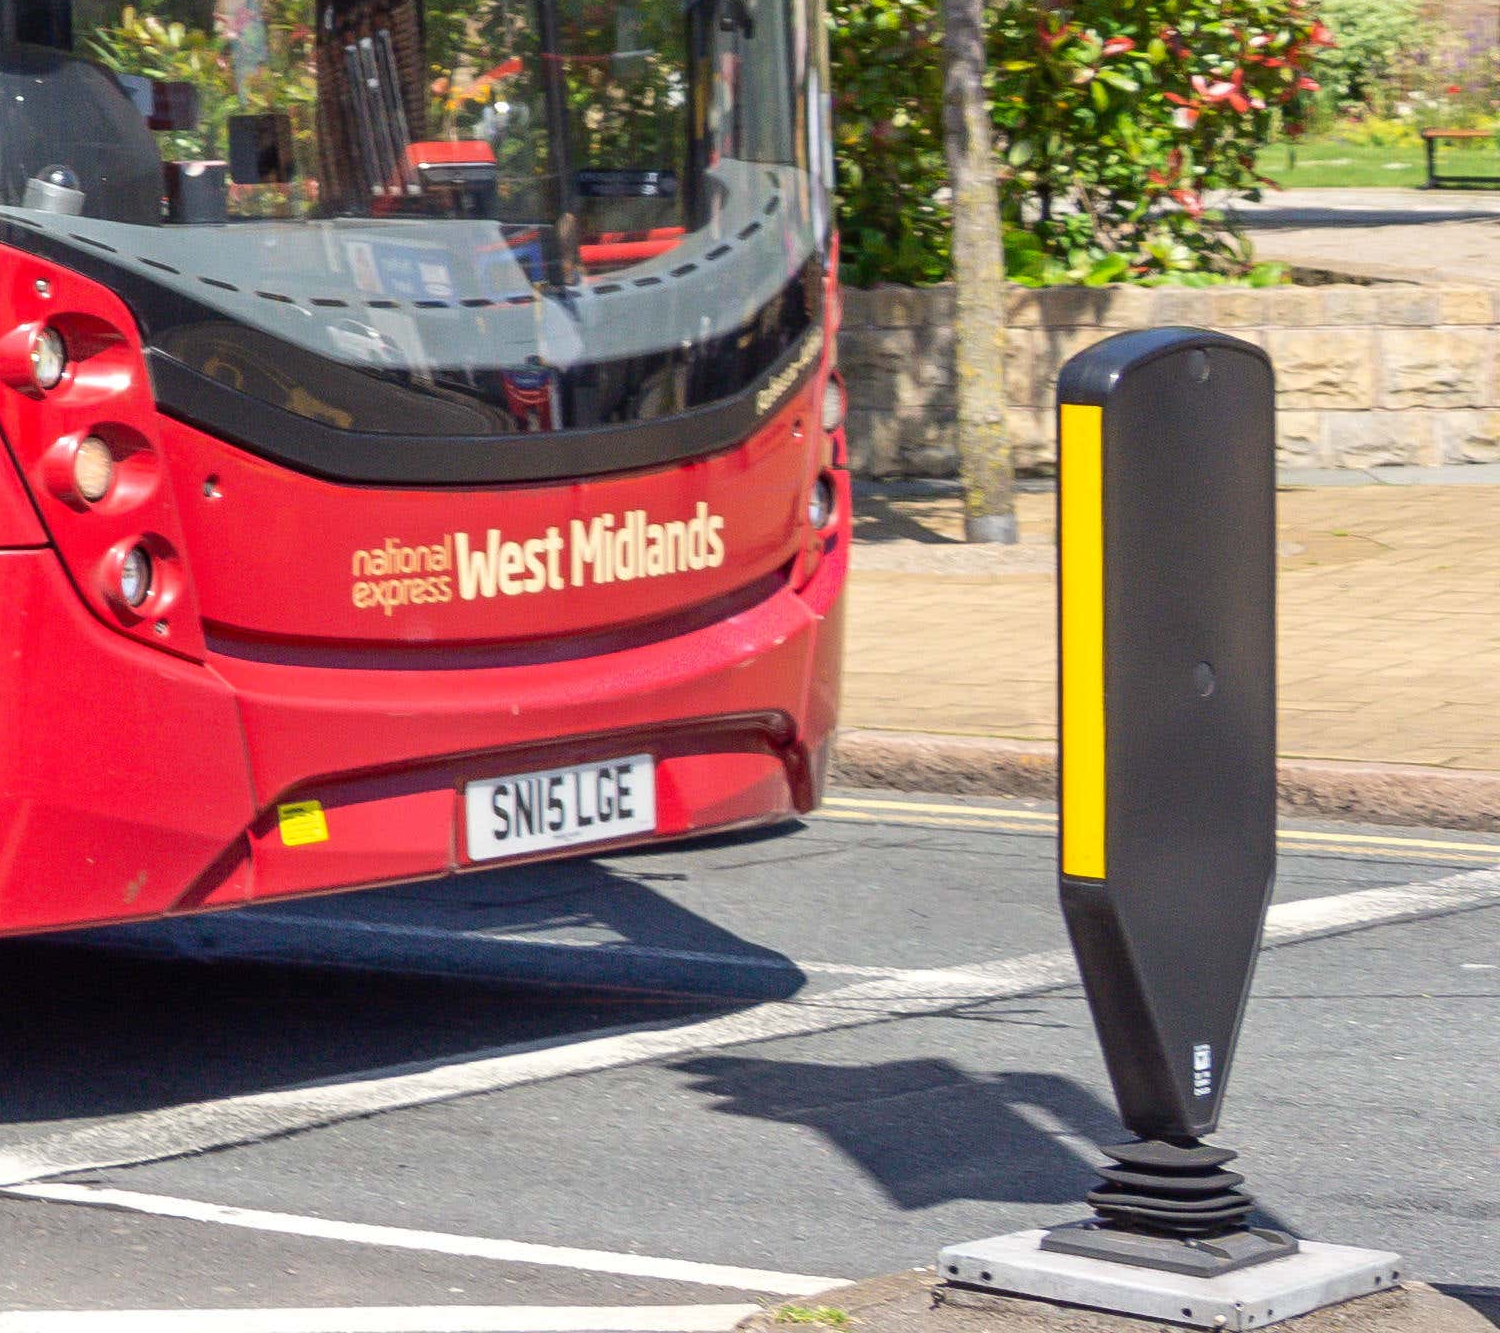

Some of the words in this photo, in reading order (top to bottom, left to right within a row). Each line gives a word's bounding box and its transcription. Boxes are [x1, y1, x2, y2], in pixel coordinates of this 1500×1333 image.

[352, 535, 452, 576] national
[454, 527, 565, 601] West
[570, 501, 725, 588] Midlands
[352, 573, 453, 617] express
[491, 776, 565, 841] SN15
[576, 763, 636, 828] LGE
